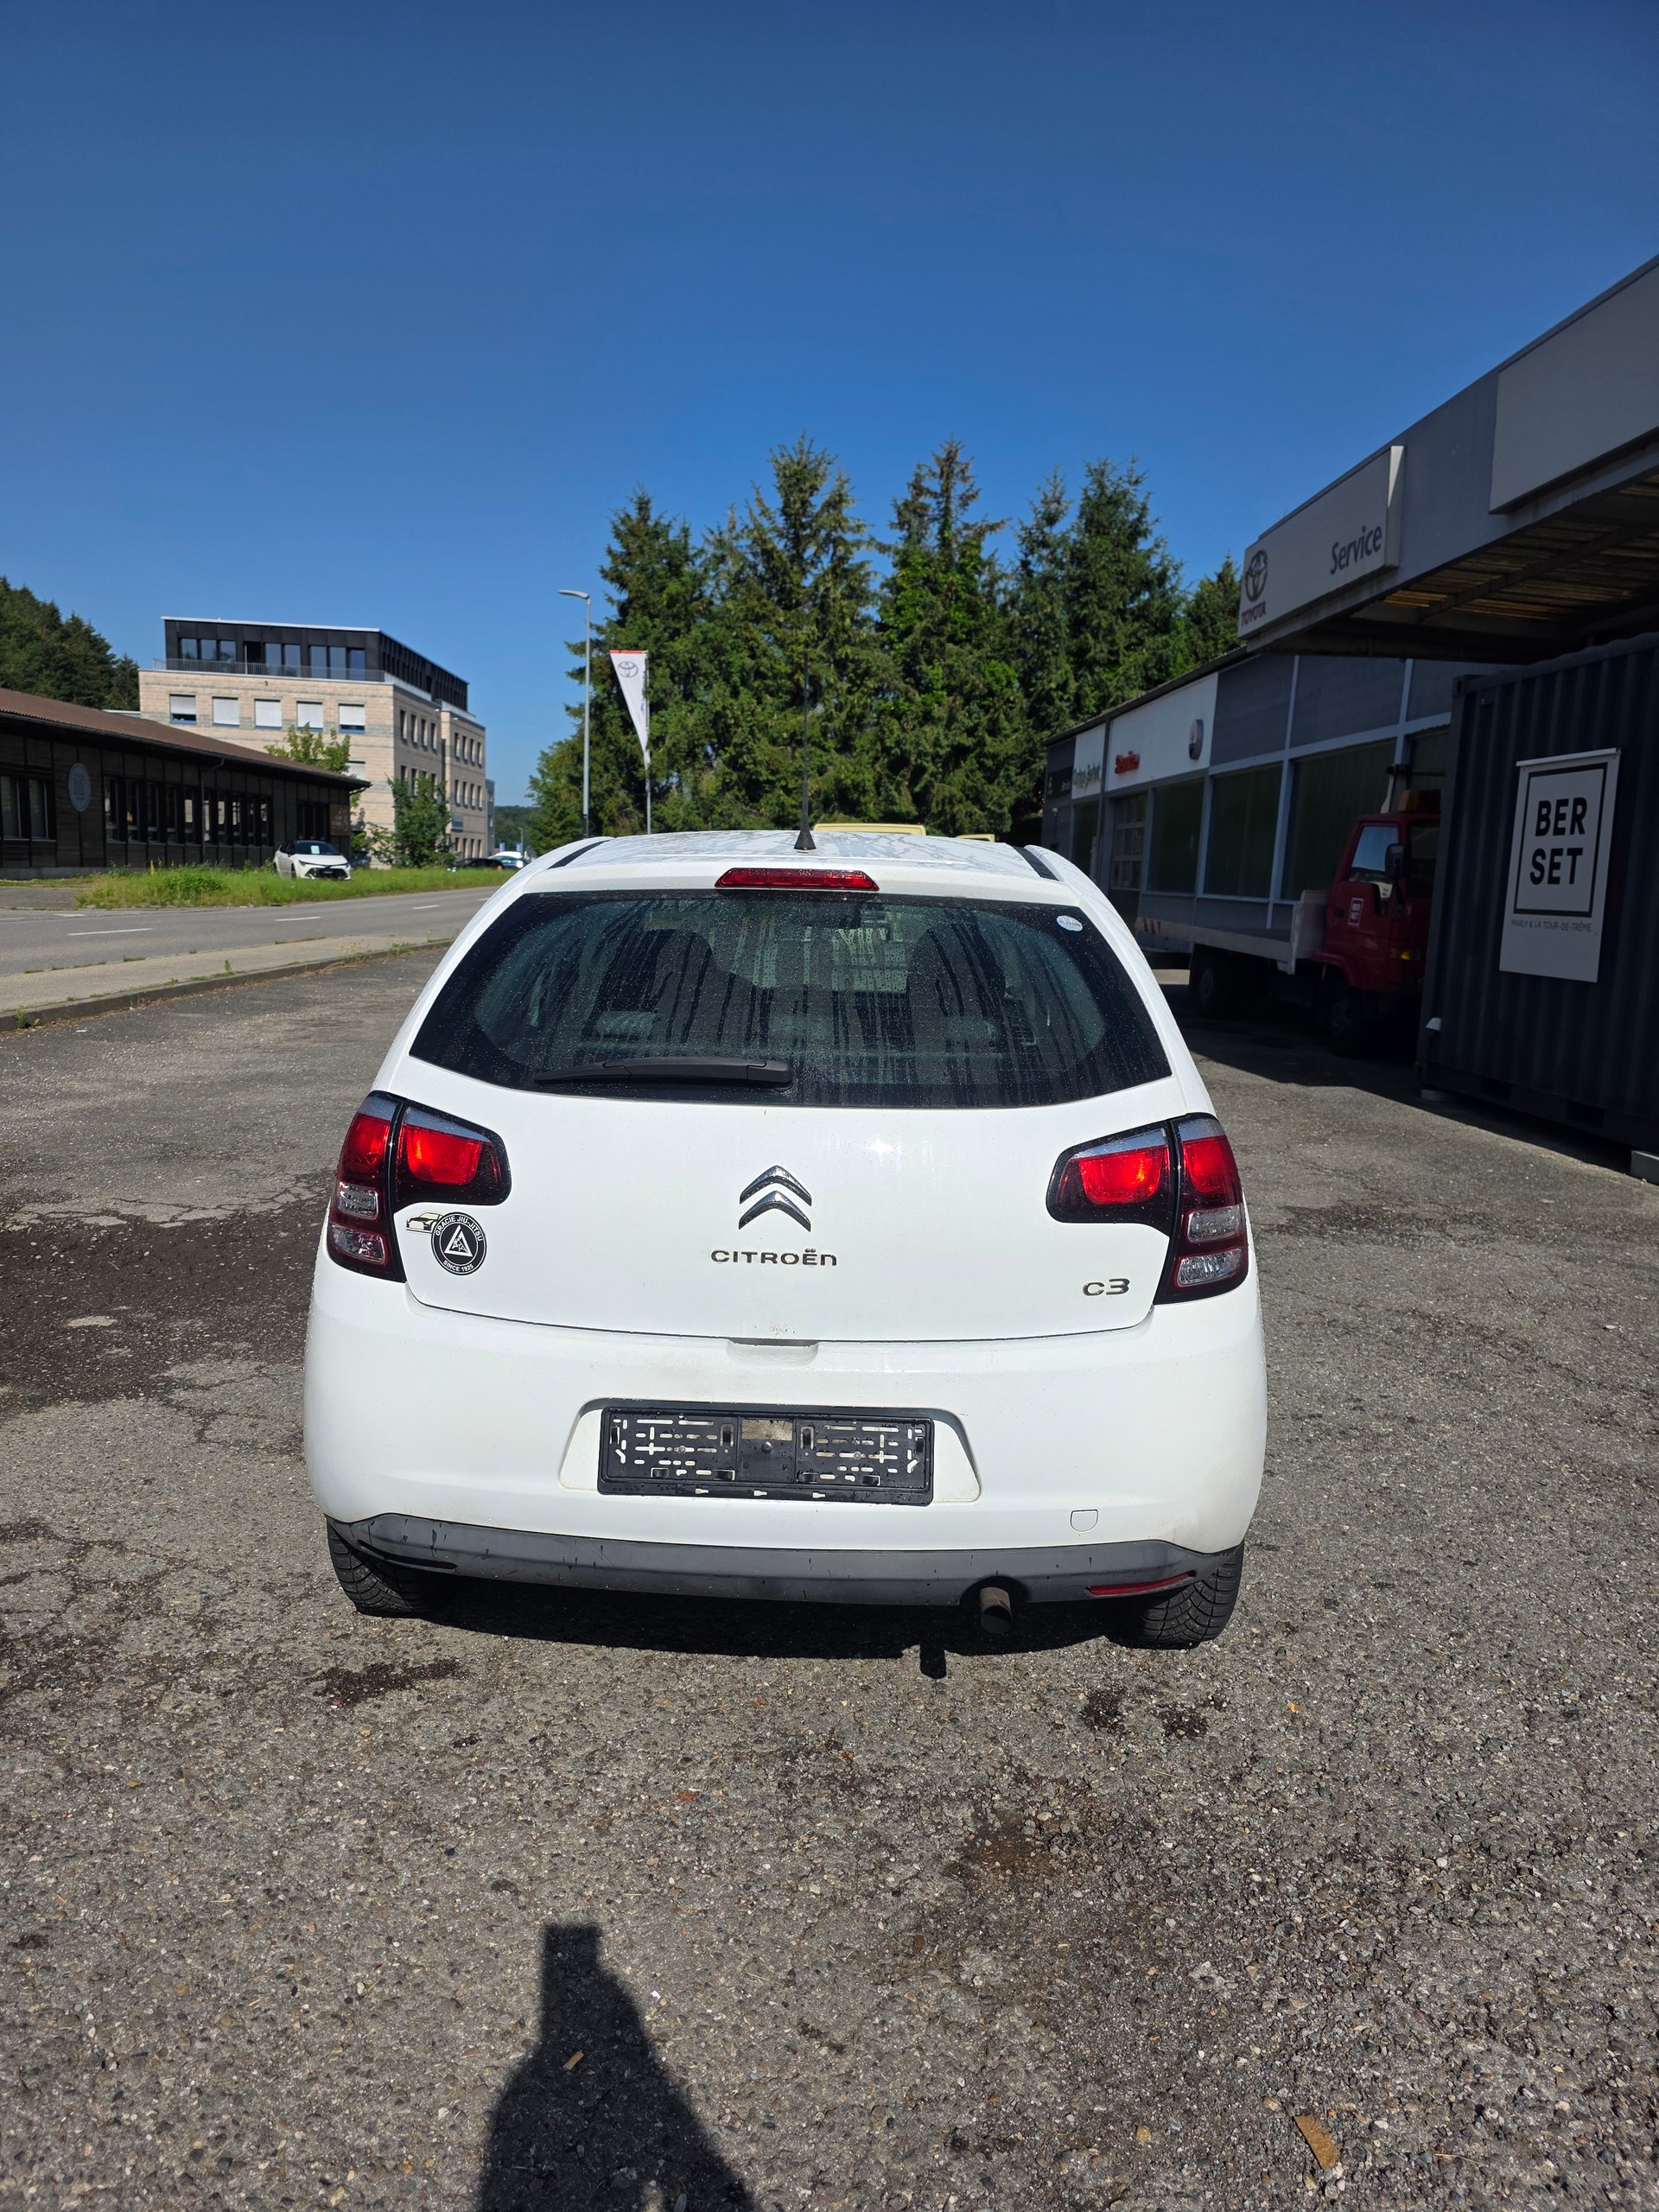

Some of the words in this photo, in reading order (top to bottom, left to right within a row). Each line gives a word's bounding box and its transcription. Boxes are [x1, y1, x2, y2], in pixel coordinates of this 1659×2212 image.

[1330, 525, 1382, 575] Service
[1241, 601, 1267, 626] TOYOTA
[1535, 797, 1587, 836] BER
[1529, 848, 1583, 885] SET
[435, 1216, 456, 1236] GRACIE
[457, 1216, 483, 1242] JIU-JITSU
[443, 1260, 460, 1271] SINCE
[1083, 1278, 1130, 1296] C3
